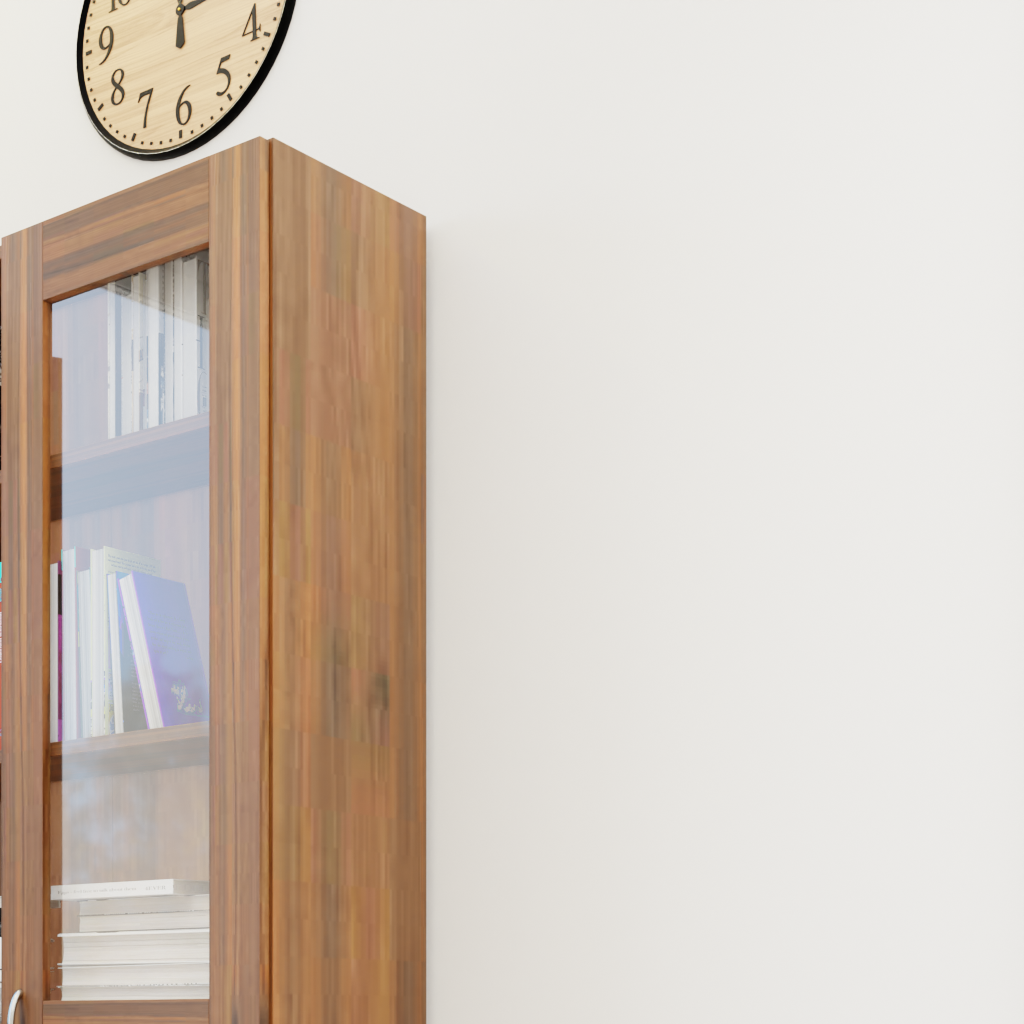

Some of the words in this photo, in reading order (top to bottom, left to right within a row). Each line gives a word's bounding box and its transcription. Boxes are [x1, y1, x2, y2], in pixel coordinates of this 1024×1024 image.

[242, 3, 261, 42] 4
[98, 26, 114, 65] 9
[111, 69, 125, 106] 8
[216, 54, 231, 96] 5
[138, 88, 154, 128] 7
[176, 85, 192, 126] 6
